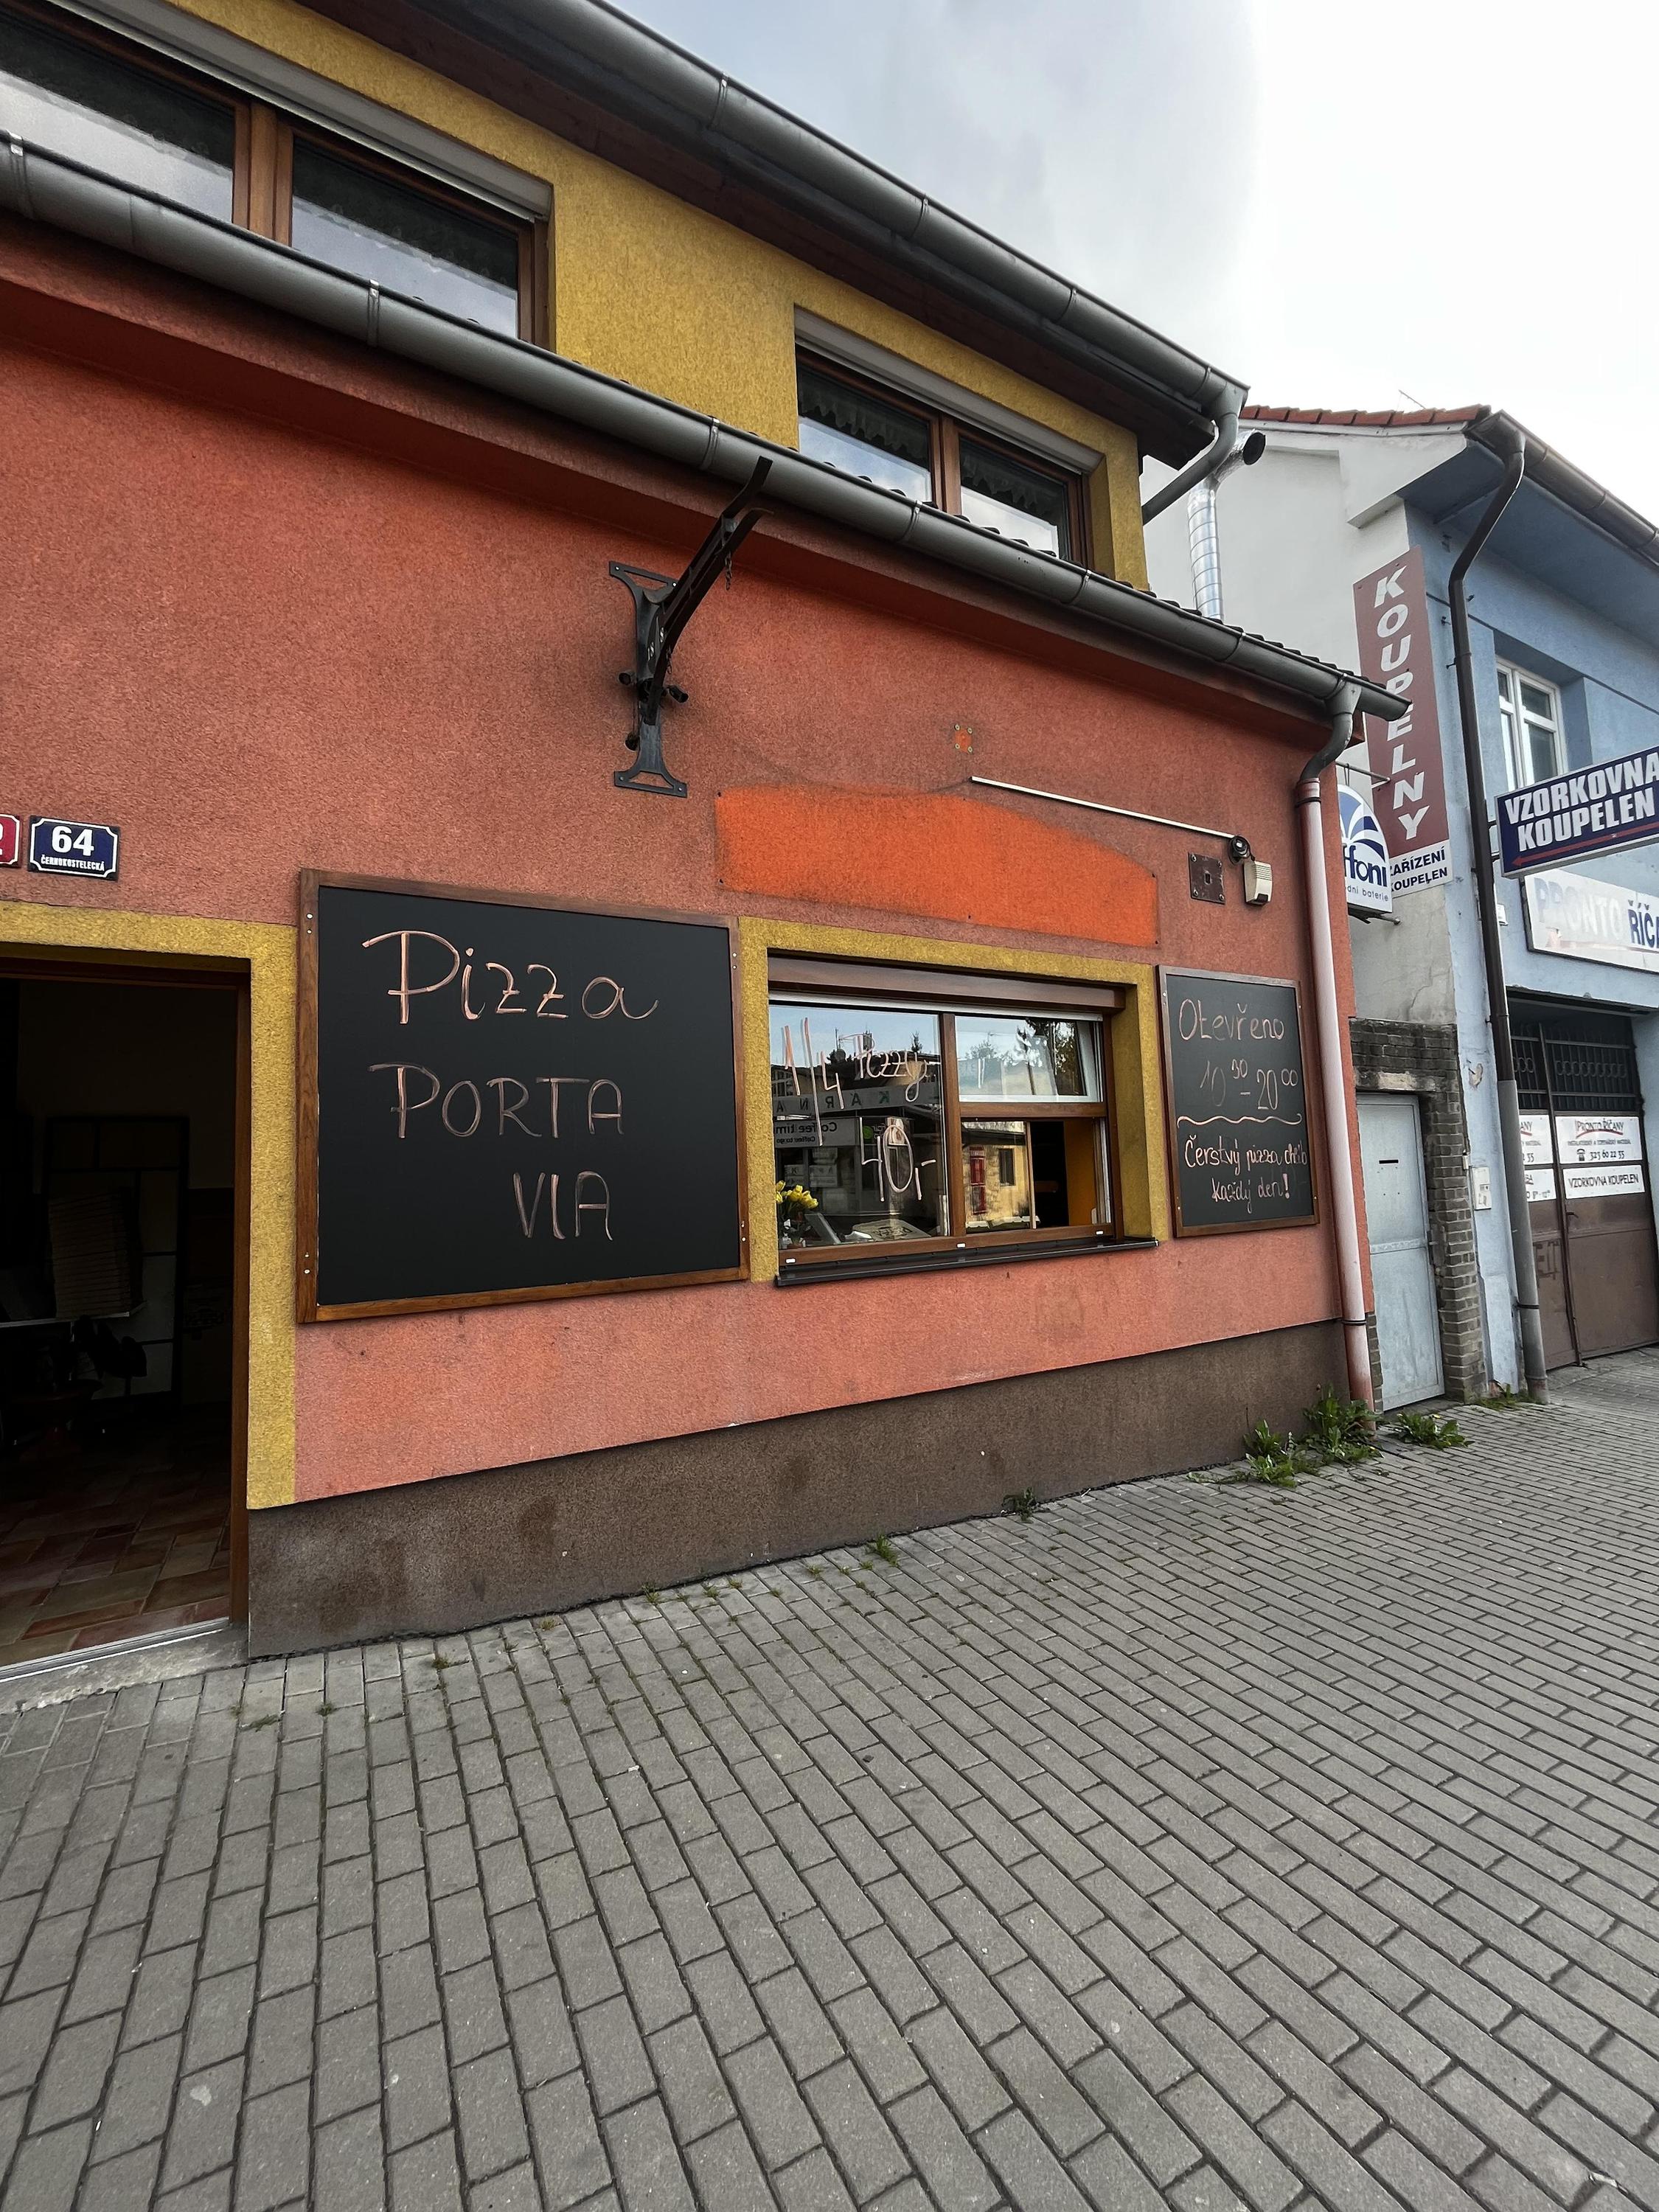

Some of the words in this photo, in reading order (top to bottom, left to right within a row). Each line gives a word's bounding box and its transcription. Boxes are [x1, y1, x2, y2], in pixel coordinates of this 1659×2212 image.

[1374, 565, 1430, 841] KOUPELNY
[1505, 752, 1659, 824] VZORKOVNA
[52, 825, 94, 856] 64
[1517, 787, 1655, 852] KOUPELEN
[41, 854, 105, 871] ČERNOKOSTELECKÁ
[1627, 899, 1659, 948] ŘÍČ
[362, 931, 659, 1025] Pizza
[1179, 998, 1284, 1041] Otevřeno
[368, 1062, 624, 1138] PORTA
[1184, 1134, 1240, 1175] Čerstvý
[1246, 1144, 1283, 1171] pizza
[512, 1171, 613, 1241] VIA
[1258, 1173, 1290, 1199] den!
[1568, 1176, 1607, 1188] VZORKOVNA
